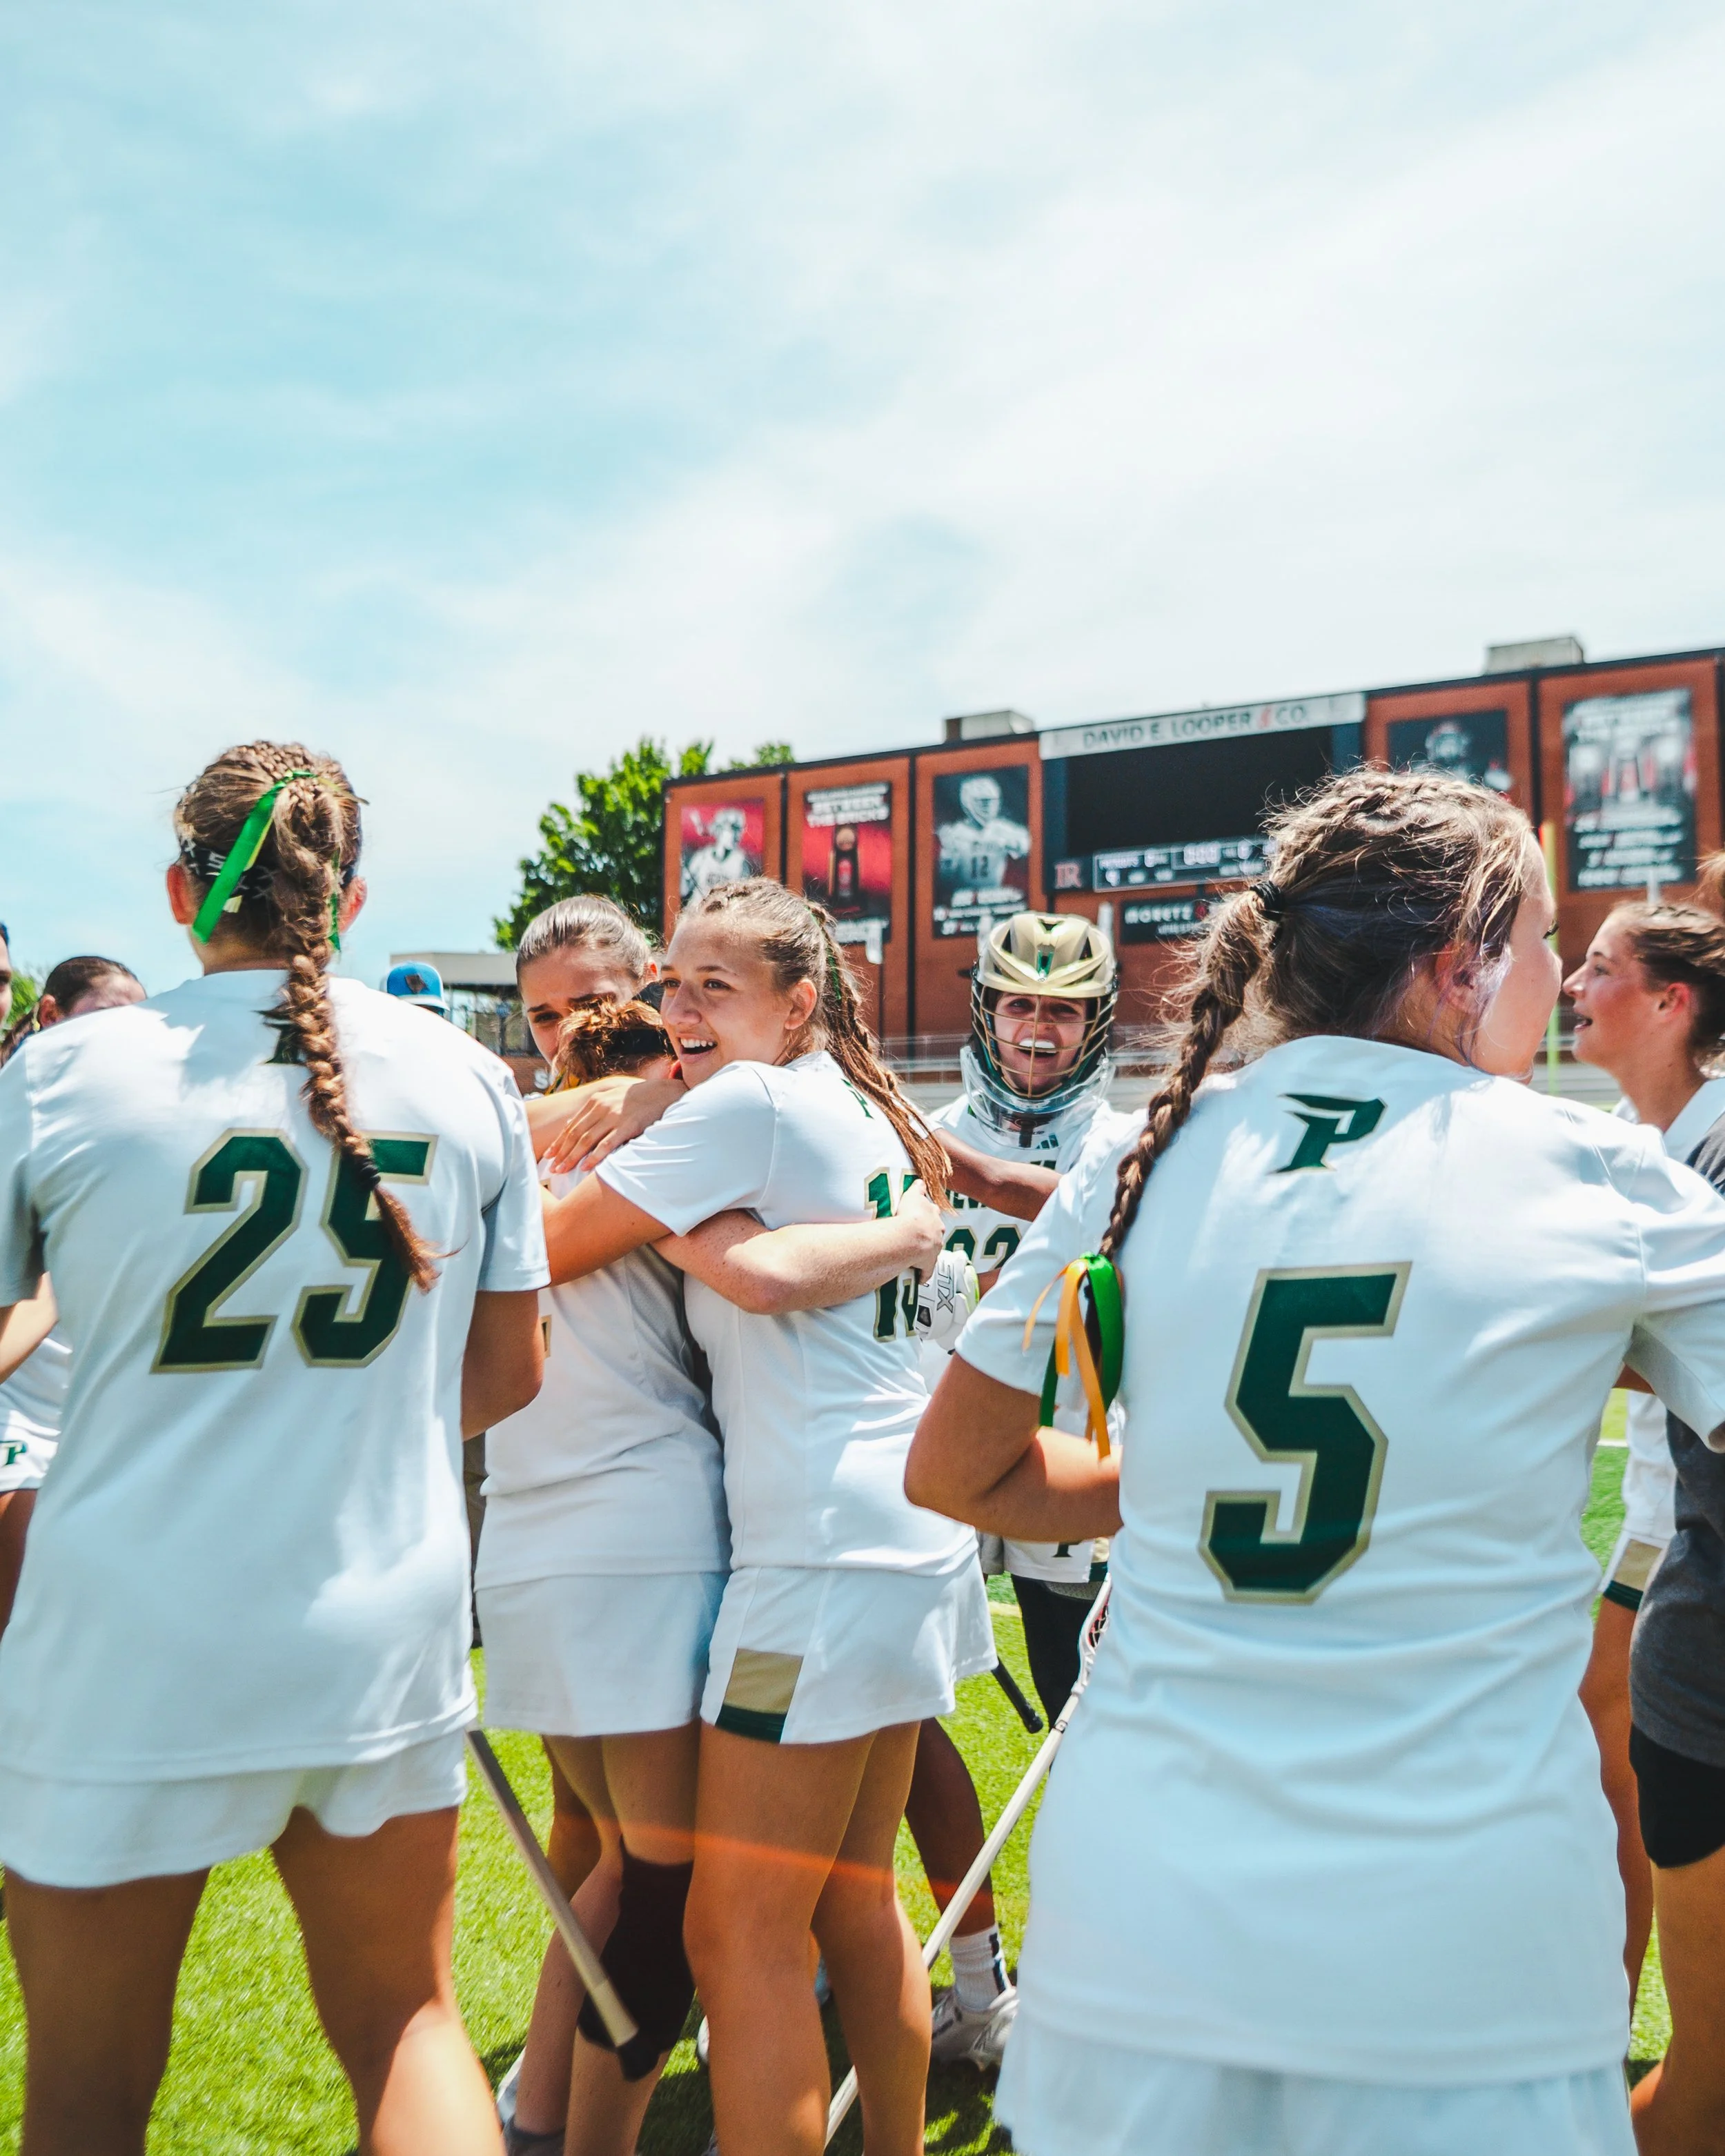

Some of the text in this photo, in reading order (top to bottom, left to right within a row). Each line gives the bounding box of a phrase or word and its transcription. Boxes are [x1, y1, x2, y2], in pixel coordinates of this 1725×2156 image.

[1083, 726, 1144, 749] DAVID
[1172, 711, 1251, 737] LOOPER
[1268, 1093, 1388, 1174] P
[150, 1127, 440, 1374] 25
[1198, 1260, 1413, 1606] 5
